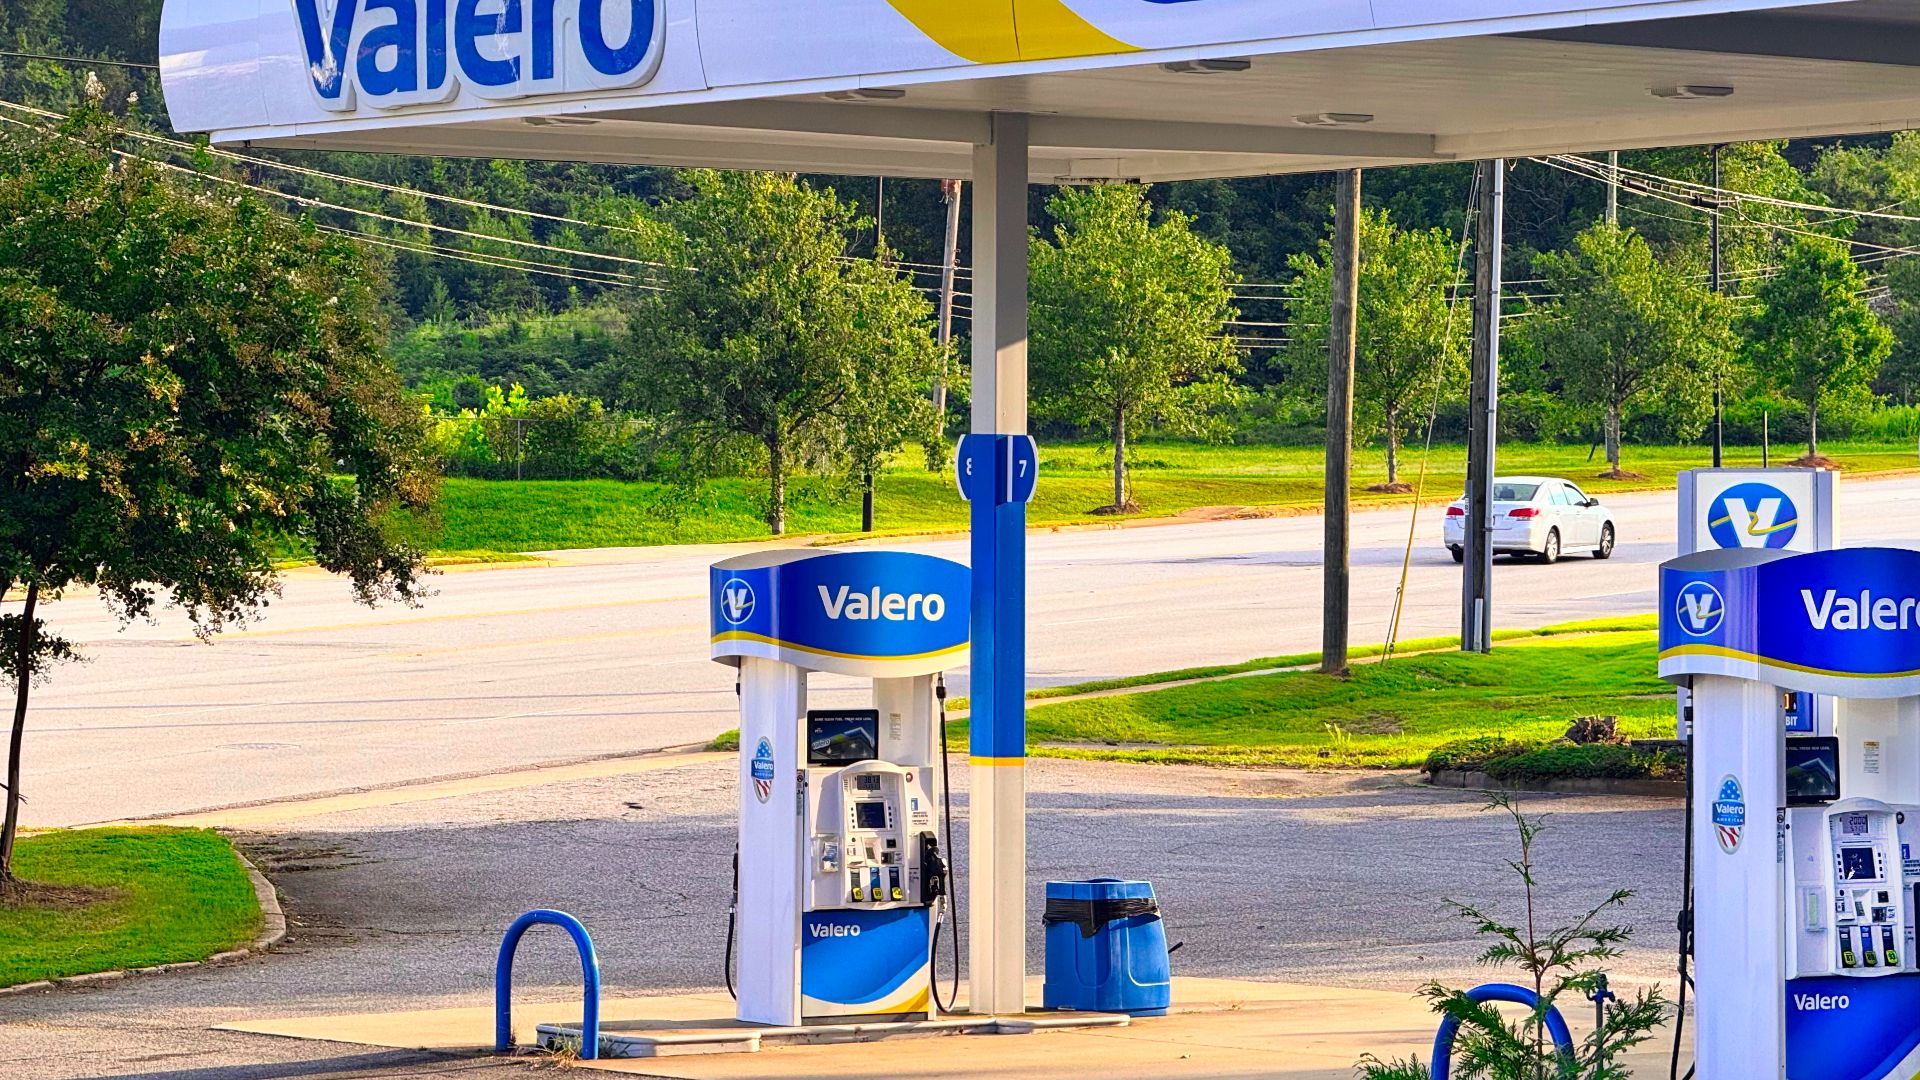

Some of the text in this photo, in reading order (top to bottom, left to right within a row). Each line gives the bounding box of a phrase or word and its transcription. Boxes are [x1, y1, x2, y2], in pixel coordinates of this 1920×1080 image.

[296, 0, 656, 99] Valero
[1018, 460, 1028, 477] 7
[818, 585, 945, 622] Valero
[1800, 589, 1920, 630] Valer
[754, 760, 774, 770] Valero
[1715, 803, 1744, 814] Valero
[809, 923, 861, 938] Valero
[1793, 993, 1850, 1011] Valero
